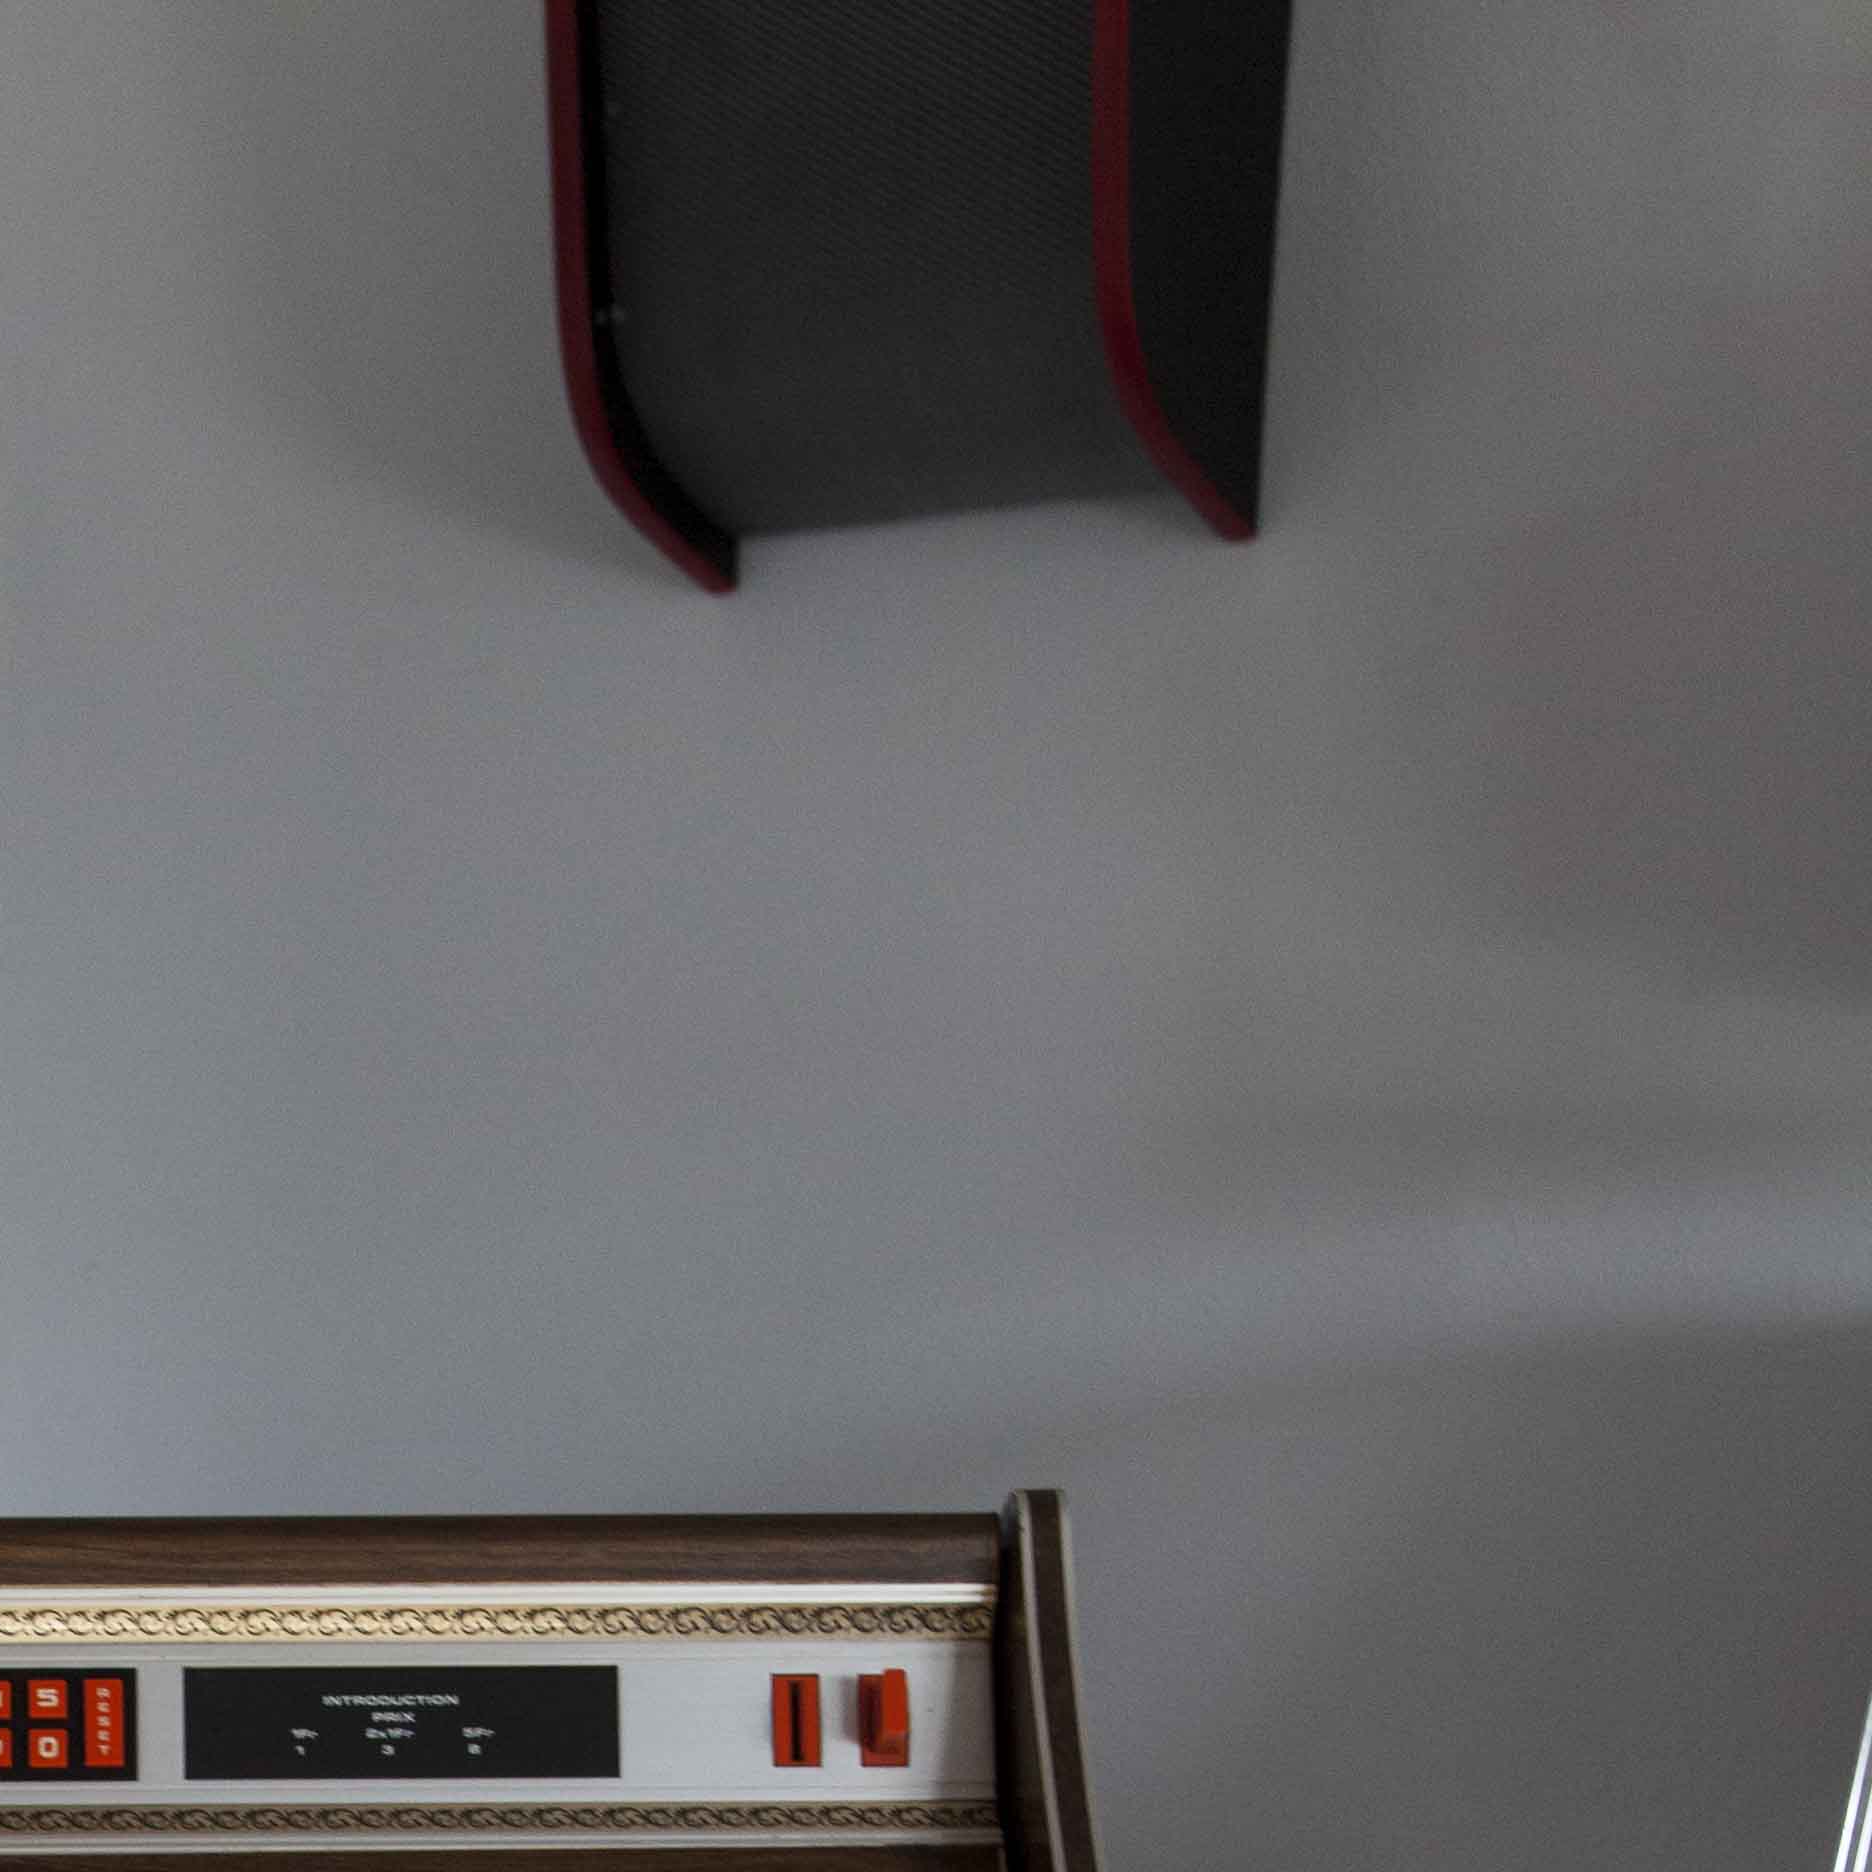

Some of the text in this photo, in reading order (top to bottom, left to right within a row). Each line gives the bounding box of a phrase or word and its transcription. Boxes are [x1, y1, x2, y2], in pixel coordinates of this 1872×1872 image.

[36, 1688, 59, 1708] 5
[321, 1694, 460, 1707] INTRODUCTION
[96, 1687, 111, 1755] RESET
[371, 1712, 416, 1722] PRIX
[37, 1736, 59, 1758] 0
